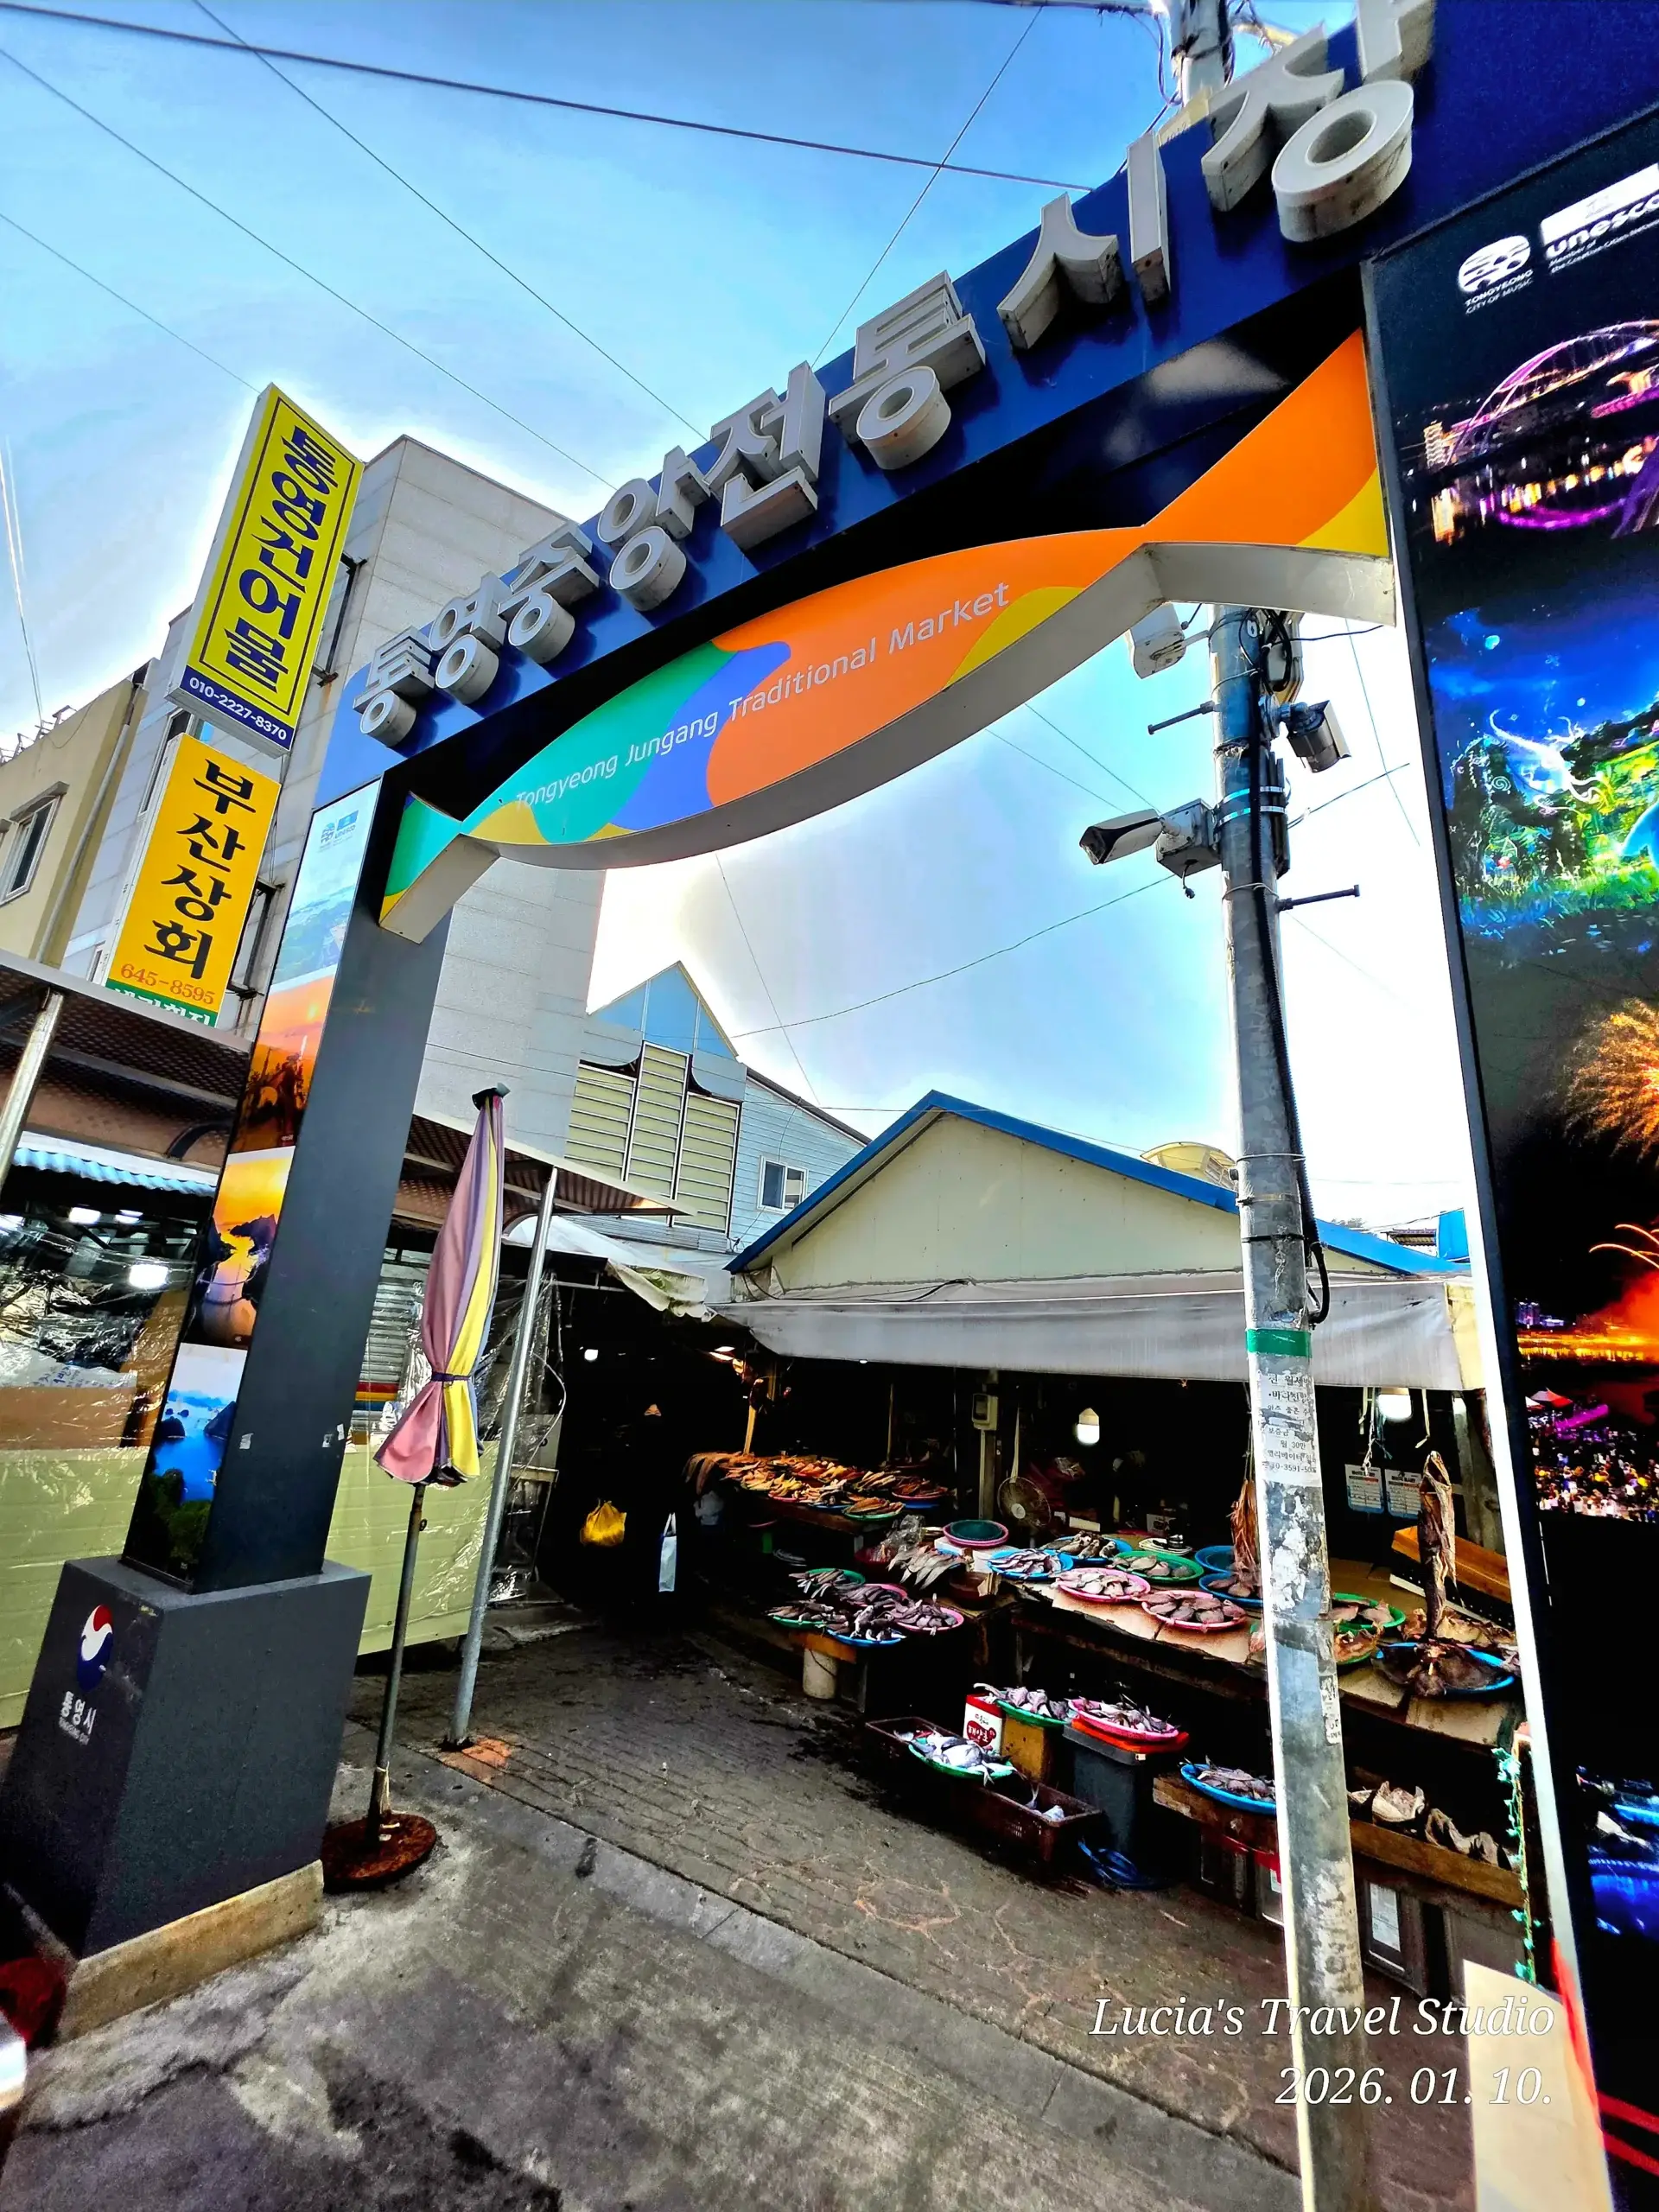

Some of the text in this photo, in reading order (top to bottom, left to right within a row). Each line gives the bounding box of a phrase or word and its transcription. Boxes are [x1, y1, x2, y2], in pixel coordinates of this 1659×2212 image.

[1546, 194, 1659, 258] unesco
[1465, 269, 1534, 307] TONGYEONG
[1465, 277, 1534, 315] CITY OF MUSIC
[353, 0, 1436, 747] 통영중앙전통시장
[224, 425, 338, 693] 통영건어물
[189, 677, 287, 741] 010-2227-8370
[516, 582, 1009, 810] Tongyeong Jungang Traditional Market
[143, 758, 257, 980] 부산상회
[121, 963, 215, 1005] 645-8595
[60, 1691, 97, 1735] 통영시
